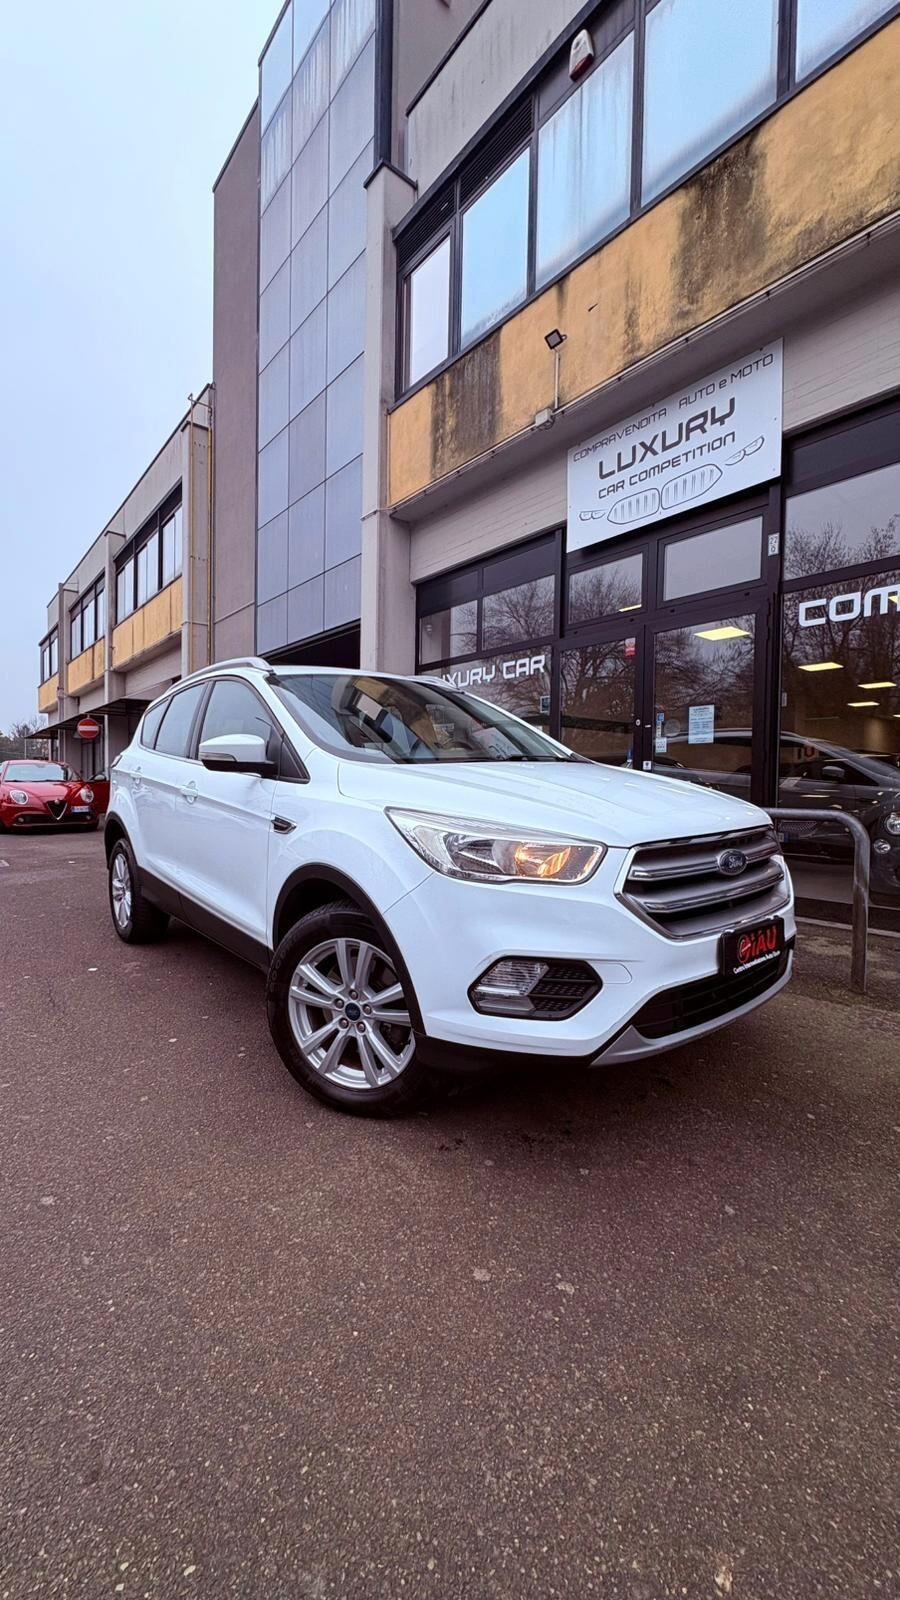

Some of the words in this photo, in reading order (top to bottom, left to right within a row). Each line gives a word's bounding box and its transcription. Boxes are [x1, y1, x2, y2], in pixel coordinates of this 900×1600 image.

[573, 408, 667, 462] COMPRAVENDITA
[679, 383, 716, 409] AUTO
[731, 353, 774, 384] MOTO
[598, 397, 736, 480] LUXURY
[598, 480, 625, 500] CAR
[629, 431, 736, 485] COMPETITION
[502, 654, 546, 680] CAR
